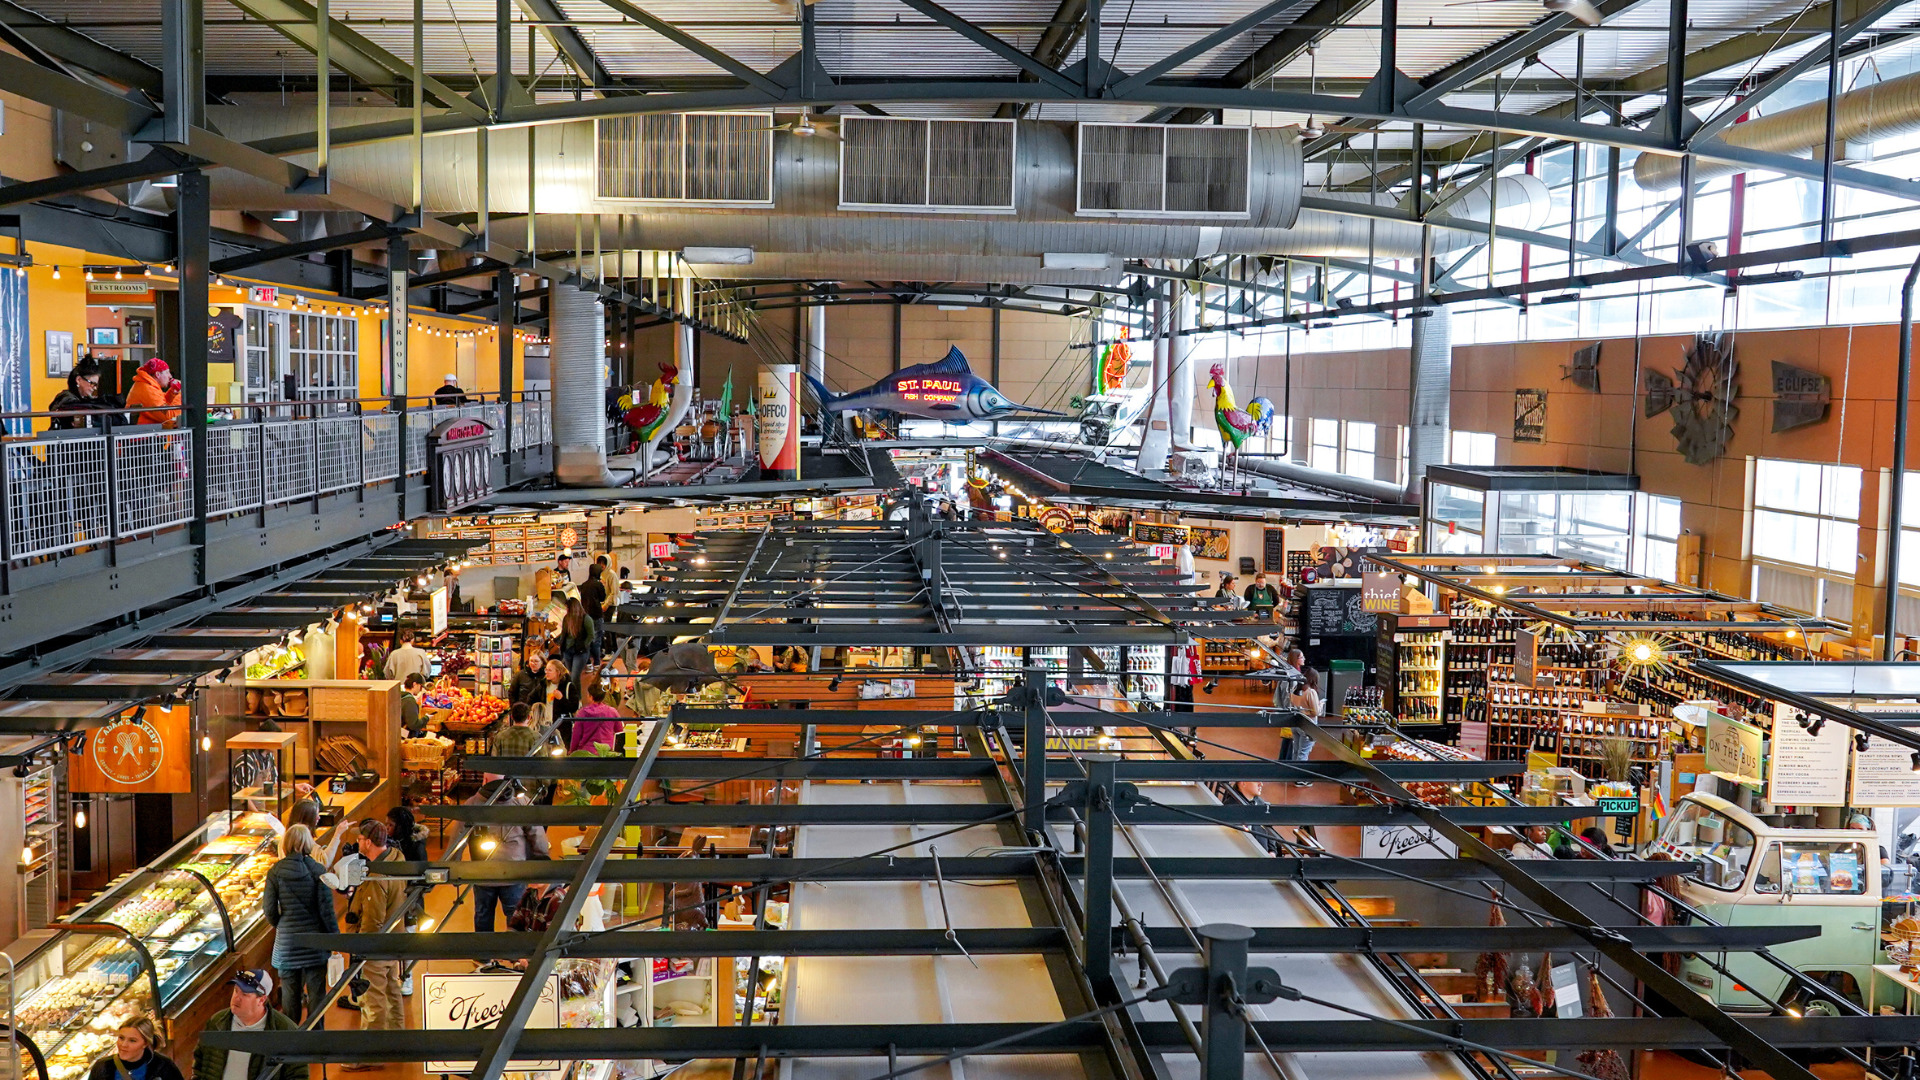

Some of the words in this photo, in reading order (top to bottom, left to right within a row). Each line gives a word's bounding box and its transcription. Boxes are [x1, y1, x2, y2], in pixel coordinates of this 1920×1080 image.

[93, 284, 144, 292] RESTROOMS
[257, 288, 275, 301] EXIT
[395, 285, 403, 380] RESTROOMS
[898, 380, 919, 392] ST.
[922, 380, 962, 392] PAUL
[1778, 377, 1820, 391] ECLIPSE
[923, 394, 957, 402] COMPANY
[654, 544, 669, 557] EXIT
[1155, 546, 1171, 558] EXIT
[1358, 564, 1385, 573] CHEE
[1364, 588, 1400, 599] thief
[1364, 599, 1400, 610] WINE
[133, 722, 159, 744] AKERY
[113, 746, 118, 754] C
[1709, 739, 1720, 752] ON
[1723, 745, 1738, 761] THE
[1741, 752, 1756, 769] BUS
[1601, 801, 1637, 811] PICKUP
[449, 993, 507, 1030] Frees
